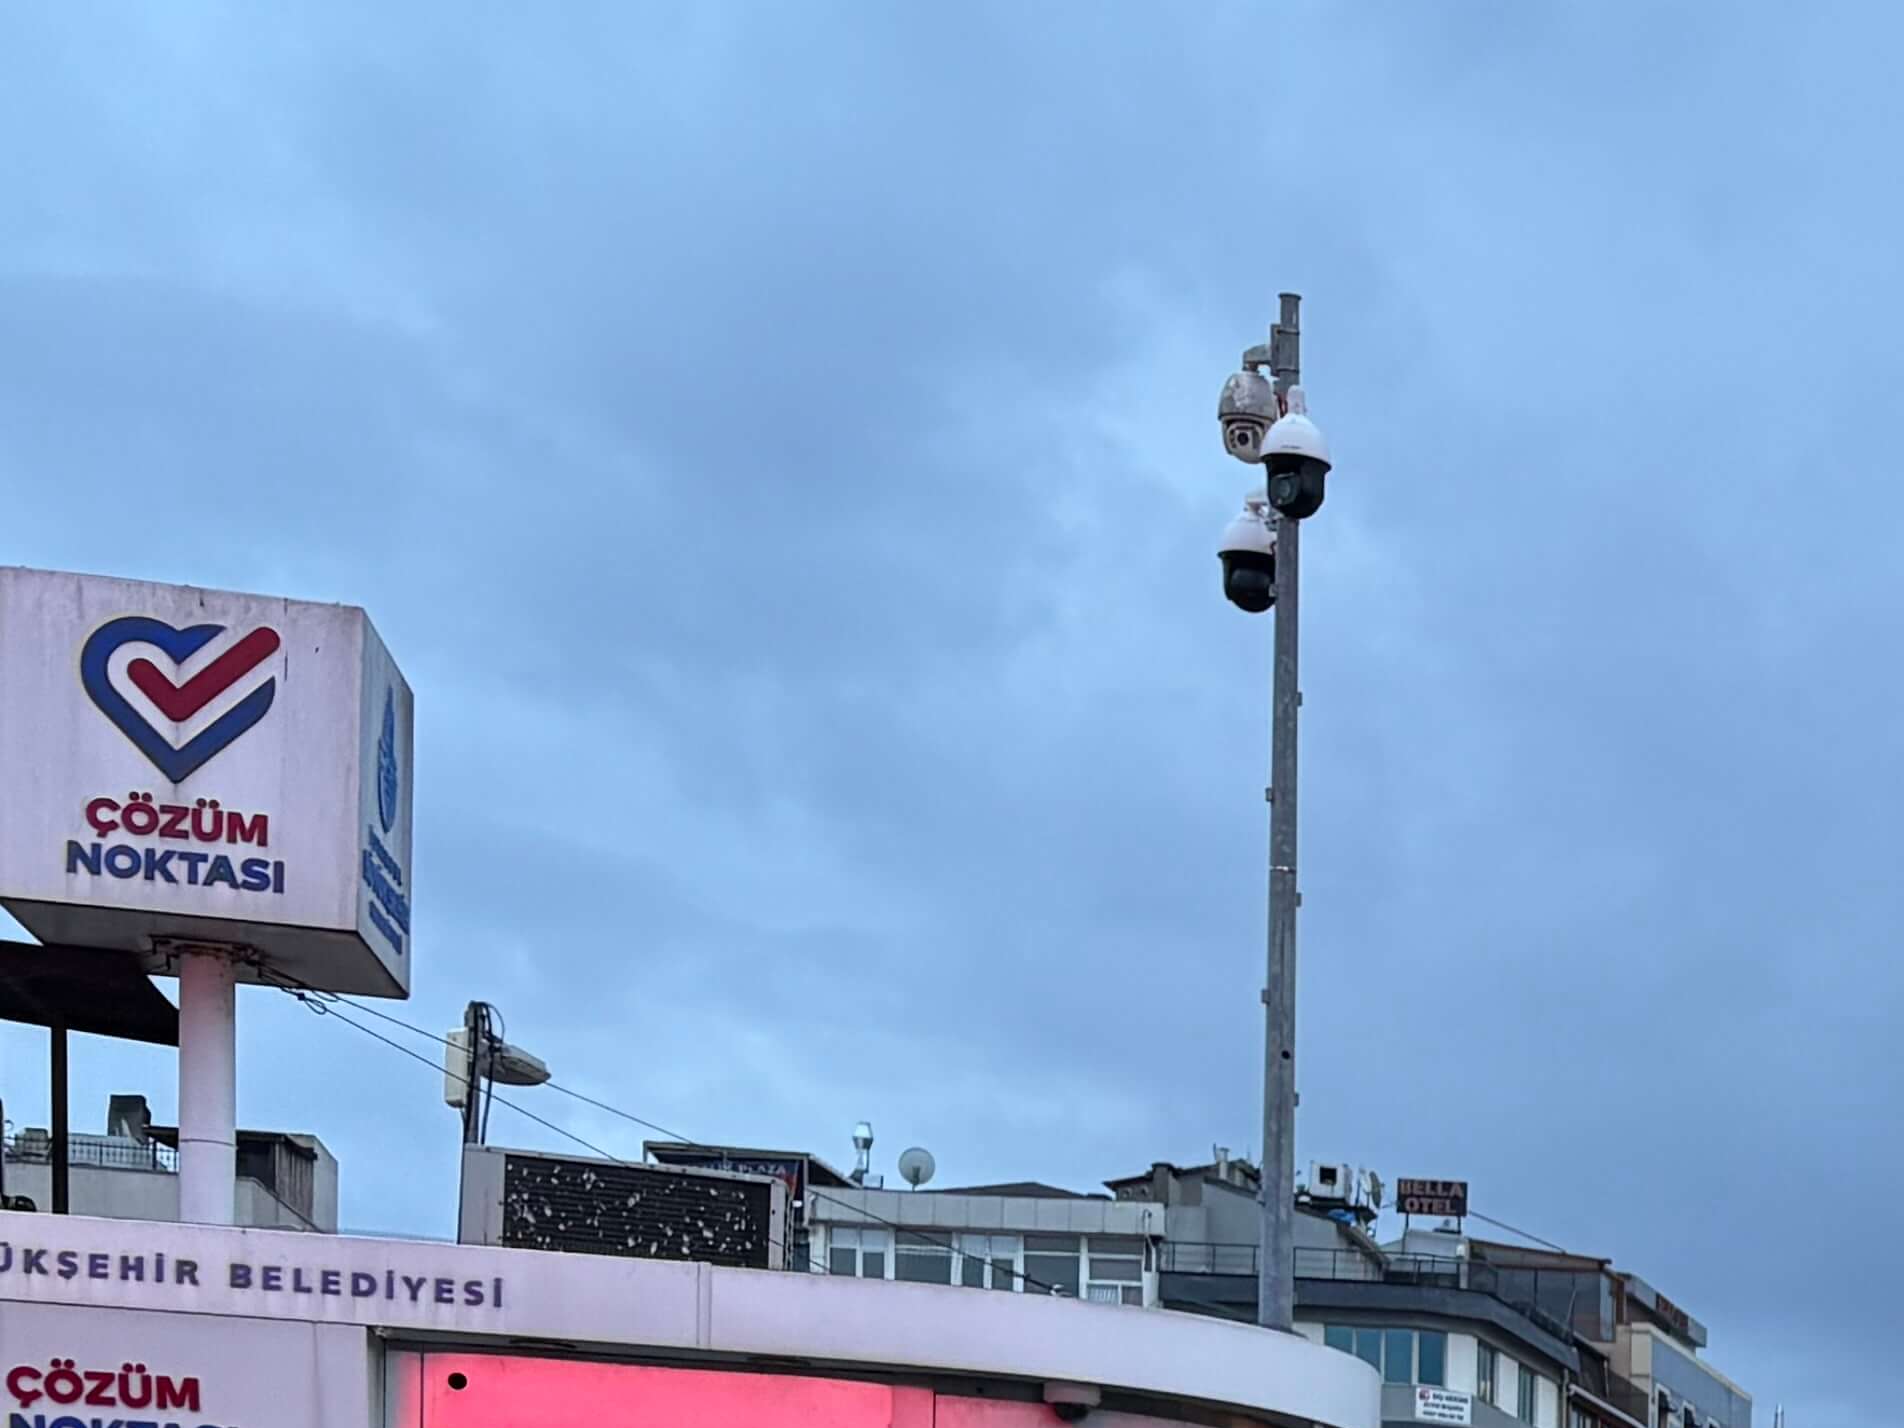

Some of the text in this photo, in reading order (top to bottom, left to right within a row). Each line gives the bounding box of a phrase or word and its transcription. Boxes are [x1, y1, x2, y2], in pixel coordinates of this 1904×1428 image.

[85, 793, 270, 848] ÇÖZÜM
[66, 840, 285, 894] NOKTASI
[1401, 1180, 1465, 1198] BELLA
[1405, 1197, 1458, 1213] OTEL
[230, 1262, 506, 1309] BELEDİYESİ
[6, 1358, 201, 1412] ÇÖZÜM
